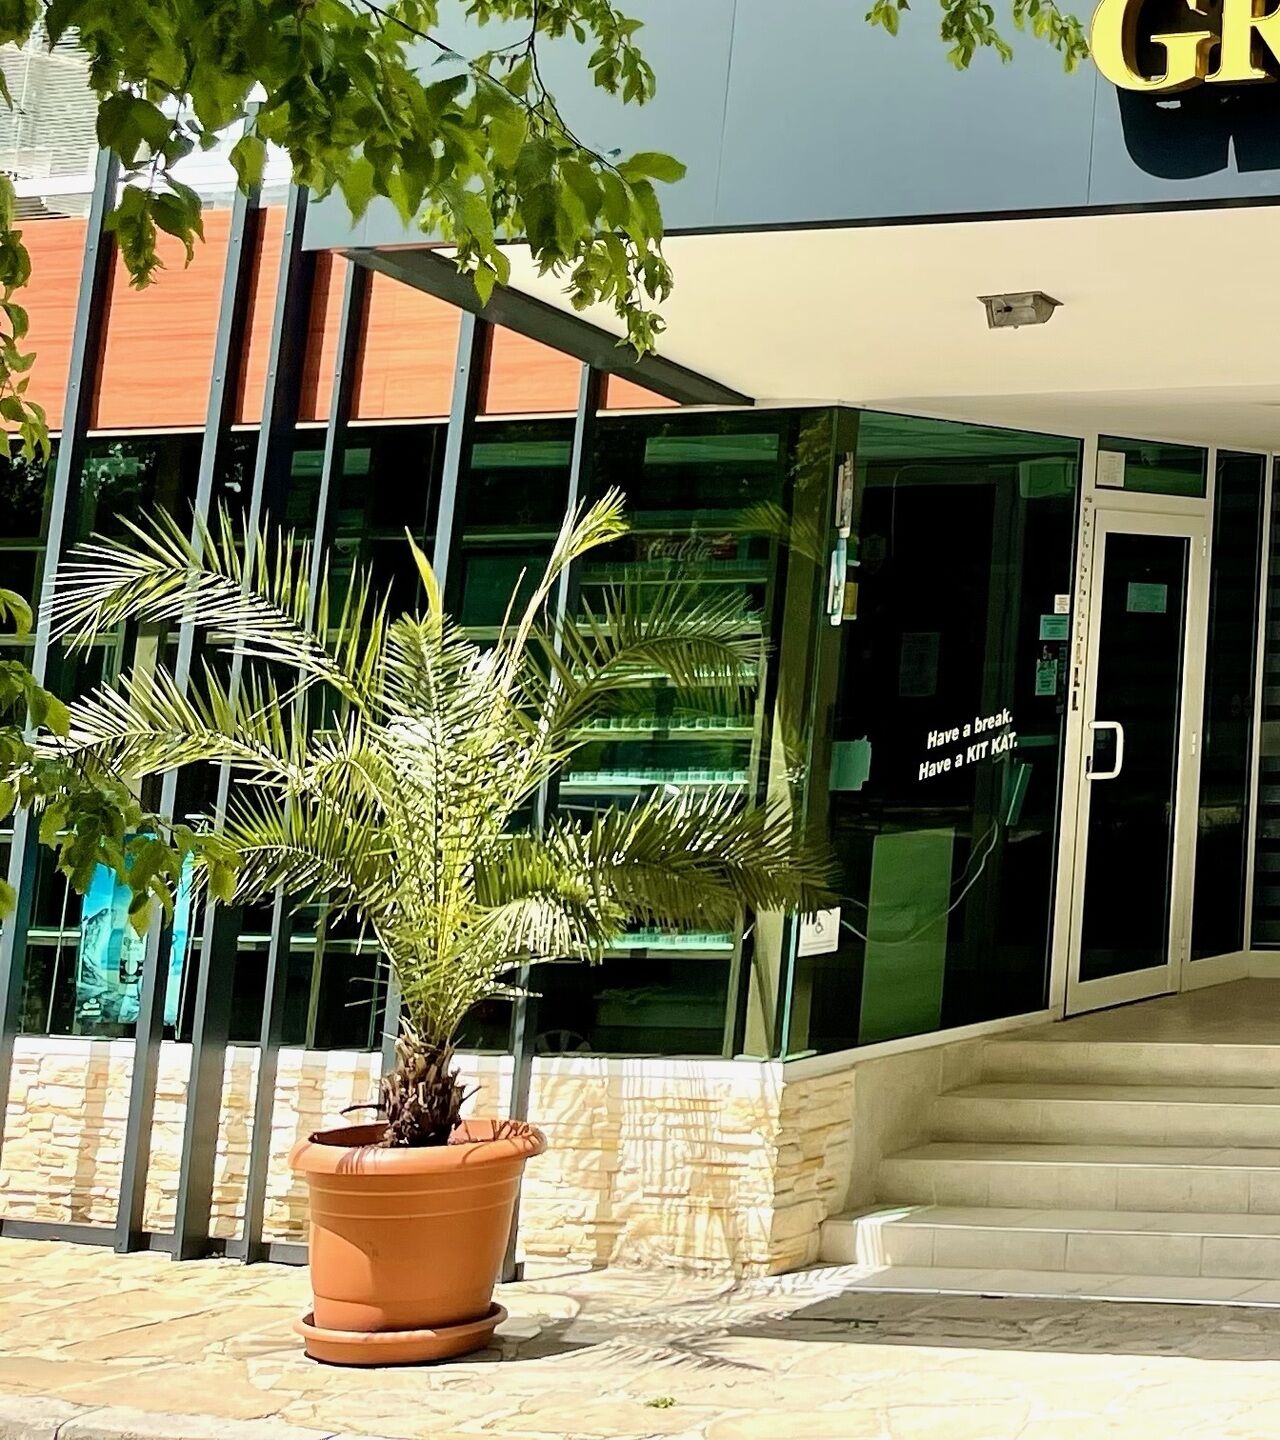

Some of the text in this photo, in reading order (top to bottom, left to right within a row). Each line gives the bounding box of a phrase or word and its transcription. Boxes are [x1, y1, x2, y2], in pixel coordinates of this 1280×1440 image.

[926, 707, 1014, 750] Have a break.
[918, 731, 1018, 781] Have a KIT KAT.
